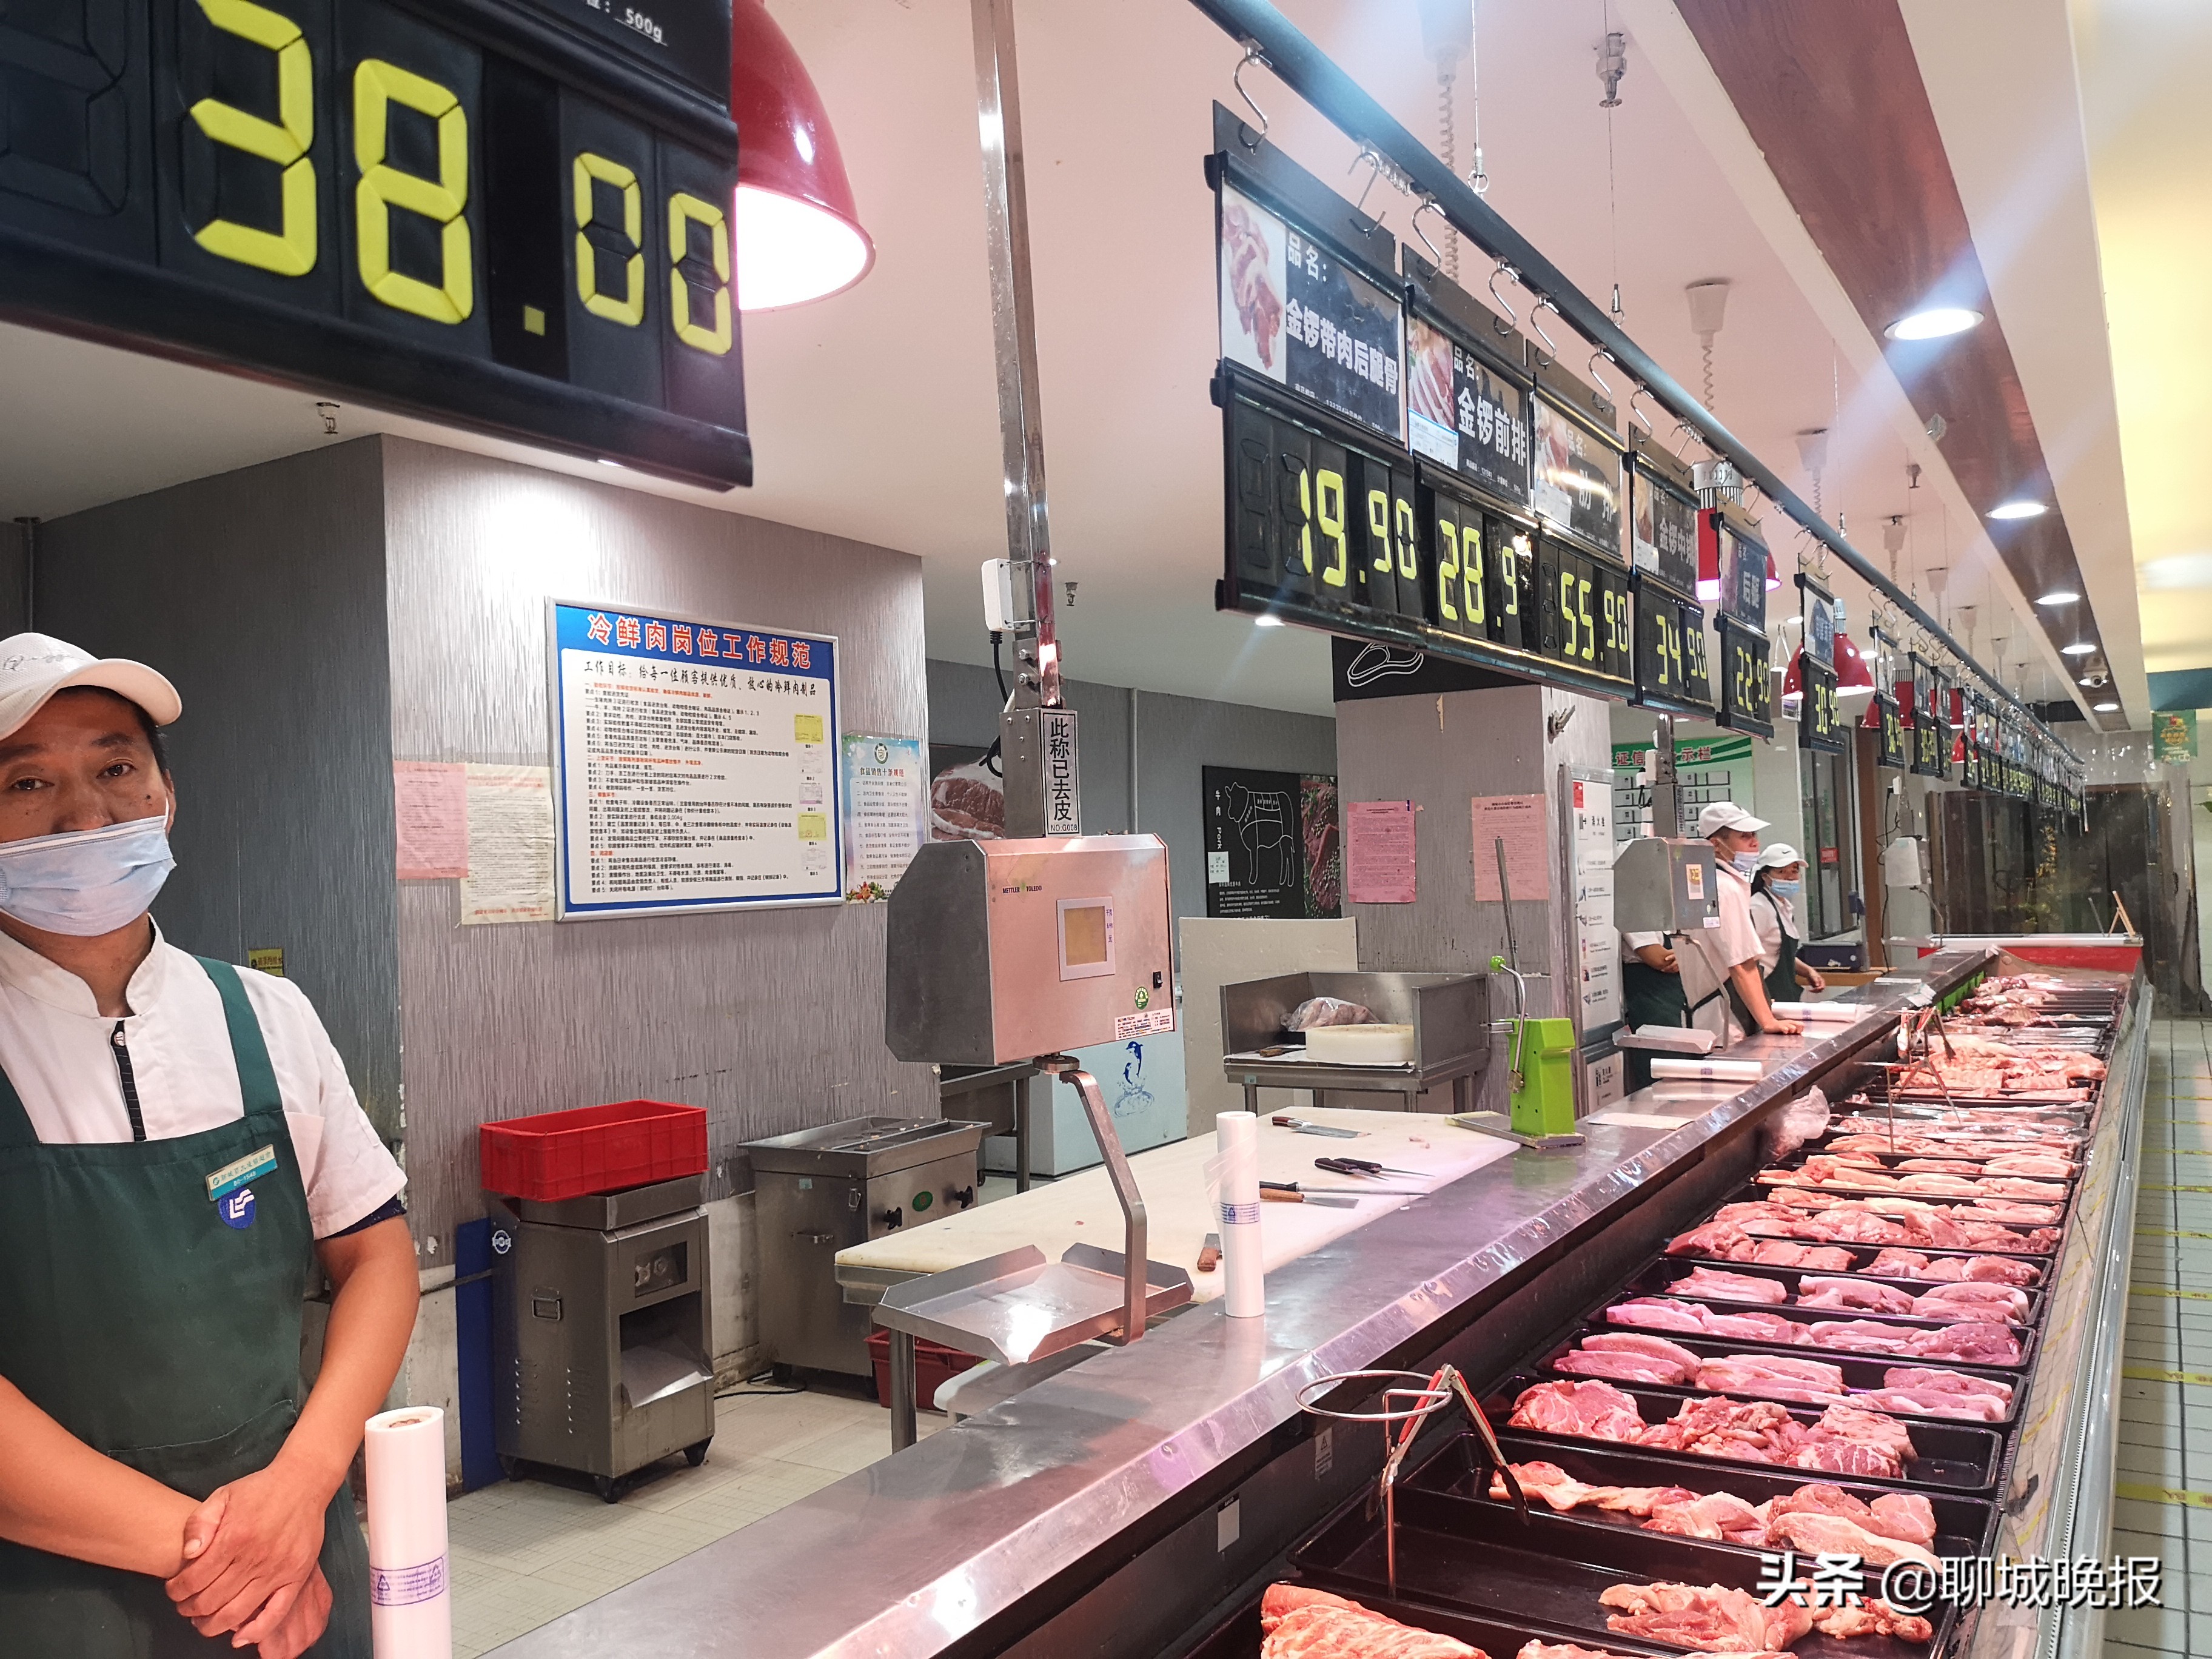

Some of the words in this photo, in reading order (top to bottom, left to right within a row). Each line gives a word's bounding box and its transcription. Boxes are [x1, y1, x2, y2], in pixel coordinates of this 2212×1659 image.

[625, 7, 663, 44] 500g
[1285, 298, 1399, 396] 金锣带肉后腿骨
[1457, 387, 1526, 467] 金锣前排
[1299, 468, 1418, 588] 19.90
[587, 613, 811, 669] 冷鲜肉岗位工作规范
[1561, 572, 1629, 662] 55.90
[1656, 614, 1708, 688] 34.90
[1737, 646, 1771, 712] 22.90
[1050, 717, 1072, 822] 此称已去皮
